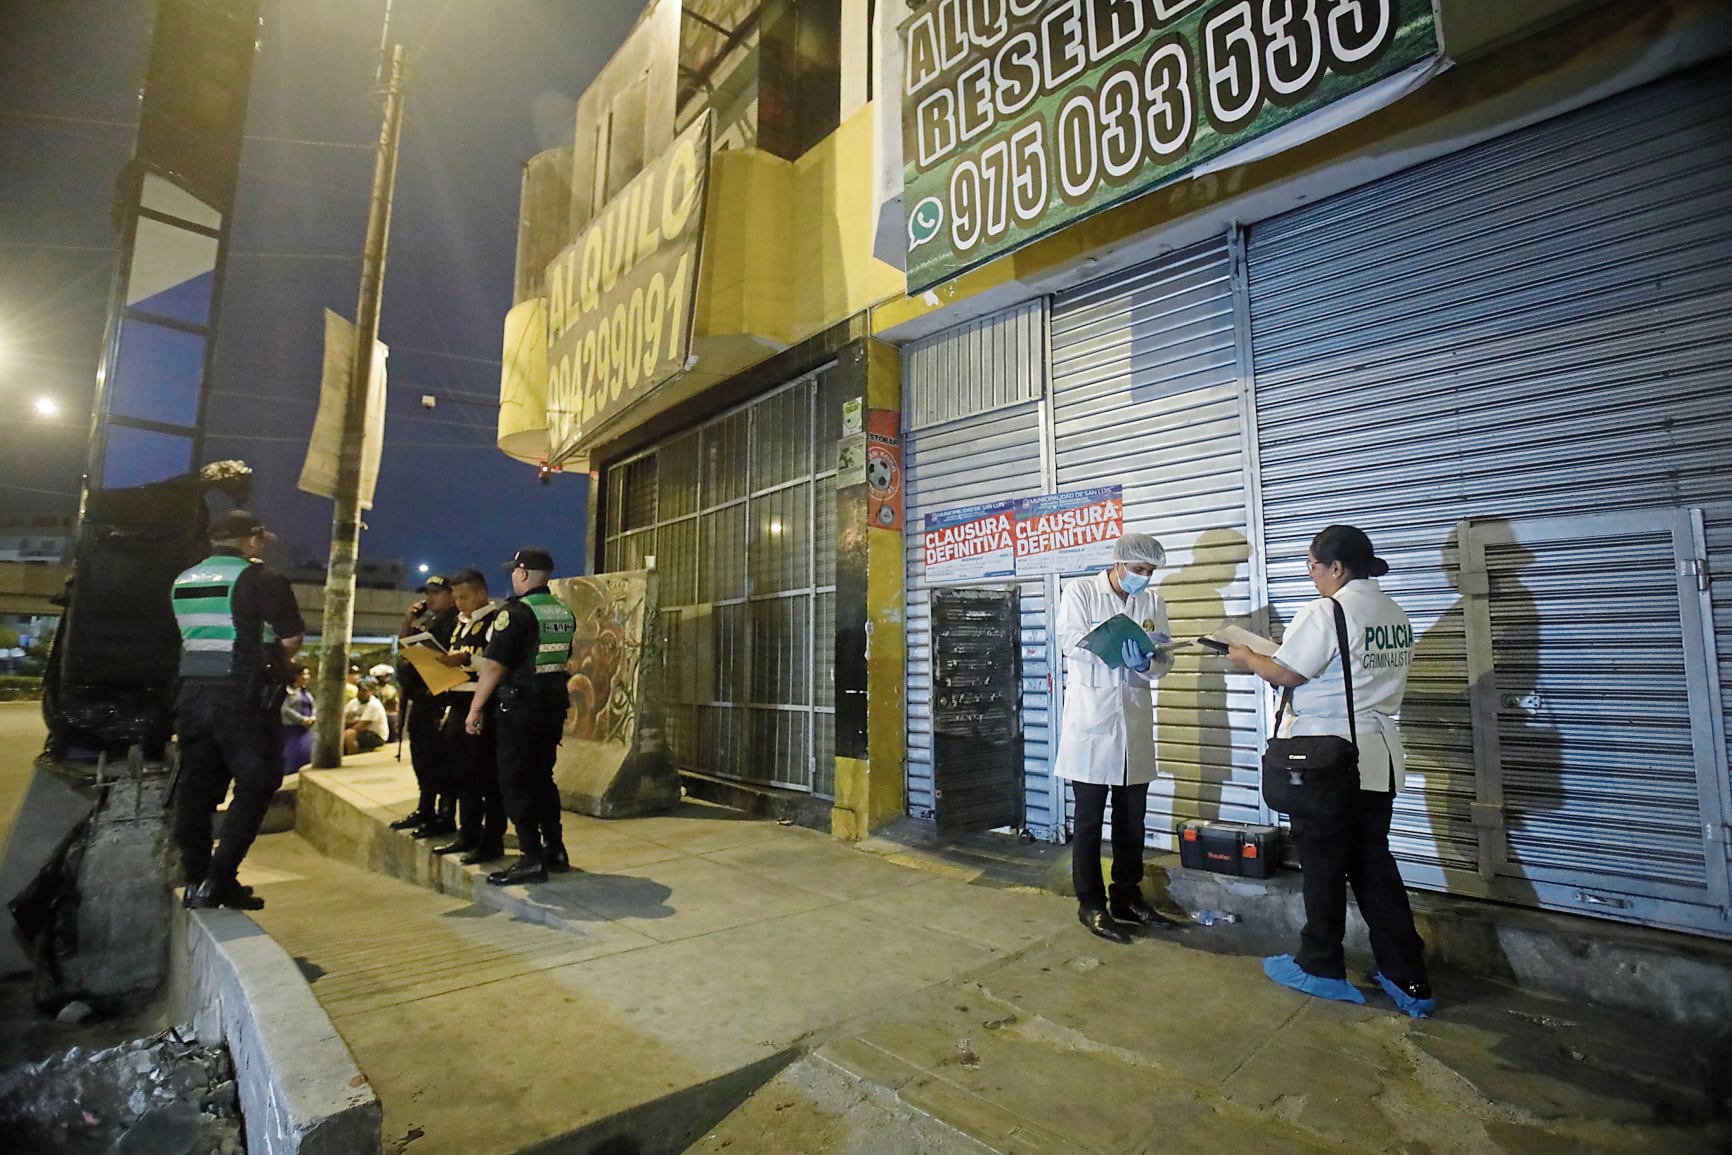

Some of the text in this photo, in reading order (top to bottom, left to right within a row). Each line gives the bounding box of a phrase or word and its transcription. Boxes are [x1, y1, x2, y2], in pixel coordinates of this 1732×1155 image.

[950, 121, 1047, 250] 975
[1058, 43, 1192, 197] 033
[548, 139, 696, 348] ALQUILO
[926, 515, 1010, 549] CLAUSURA
[1015, 500, 1118, 538] CLAUSURA
[926, 531, 1013, 564] DEFINITIVA
[1016, 520, 1121, 556] DEFINITIVA
